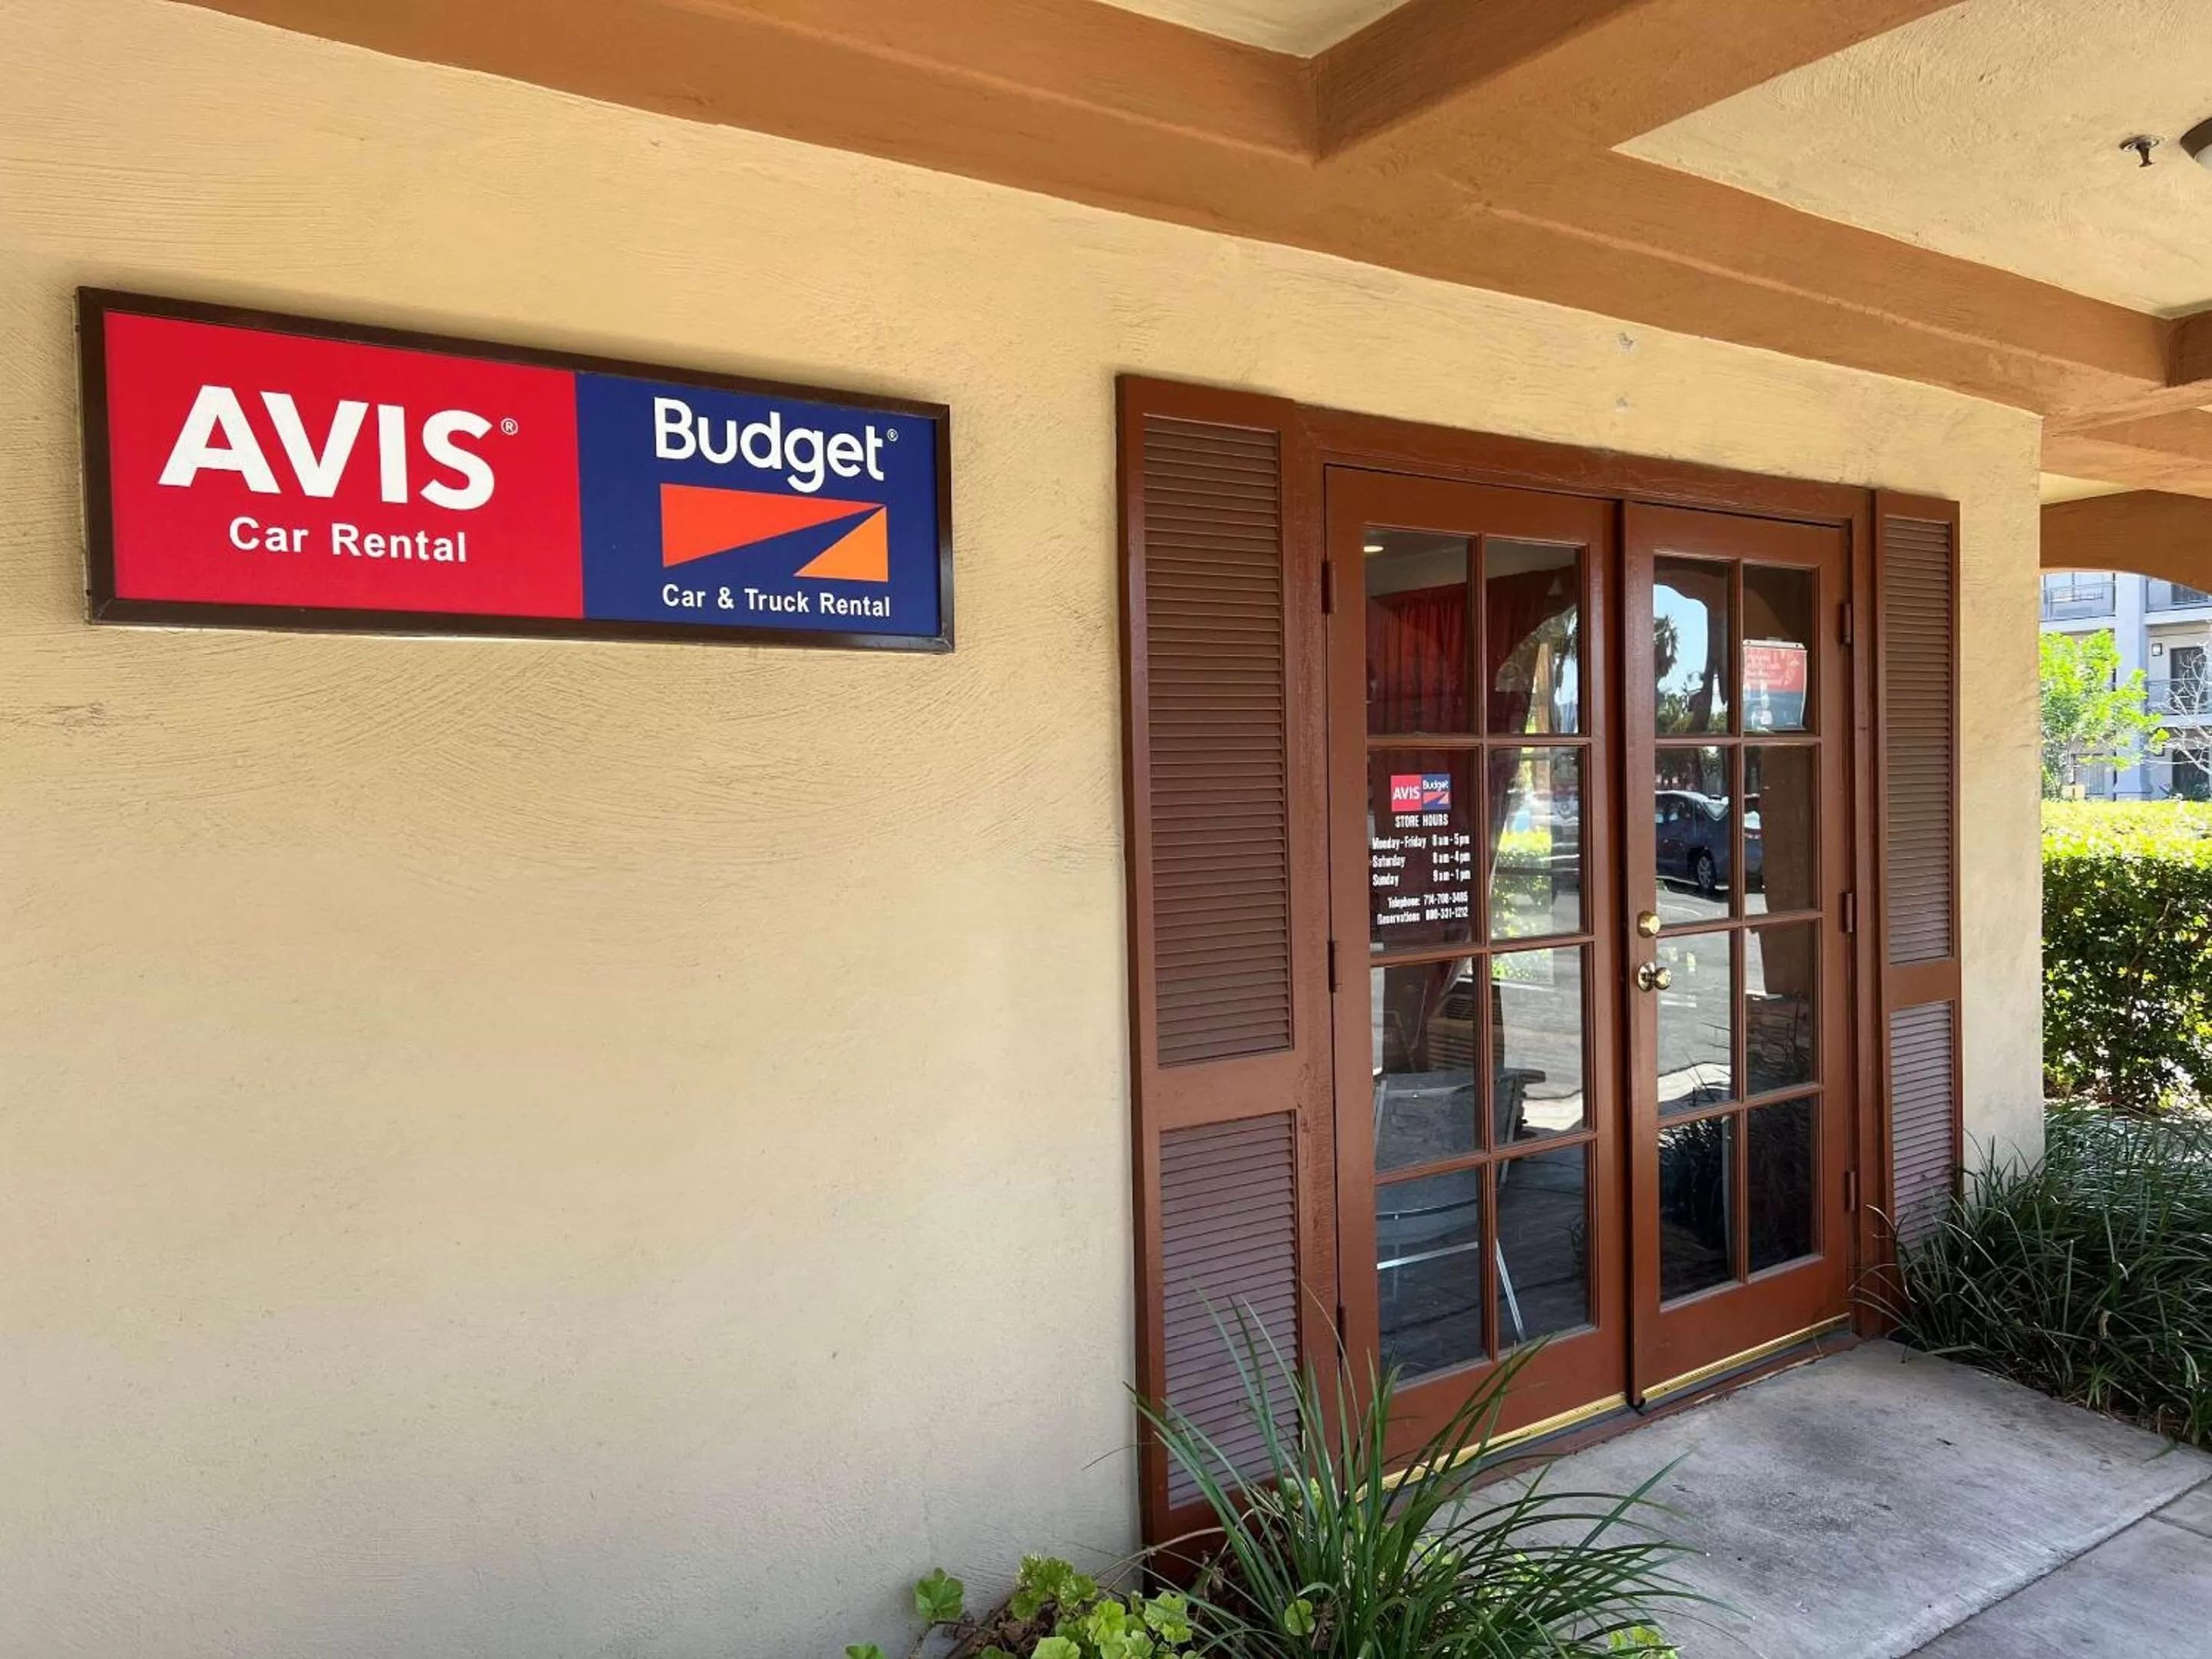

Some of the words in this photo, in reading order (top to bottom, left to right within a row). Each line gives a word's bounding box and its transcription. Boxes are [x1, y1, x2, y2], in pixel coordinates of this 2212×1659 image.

[158, 383, 495, 511] AVIS
[654, 396, 885, 493] Budget
[228, 516, 308, 552] Car
[332, 522, 467, 562] Rental
[661, 583, 706, 608] Car
[717, 586, 734, 610] &
[744, 588, 810, 613] Truck
[819, 592, 891, 618] Rental
[1392, 786, 1420, 800] AVIS
[1422, 779, 1449, 791] Budget
[1395, 814, 1419, 828] STORE
[1422, 813, 1449, 827] HOURS
[1372, 853, 1406, 869] Saturday
[1372, 873, 1399, 887] Sunday
